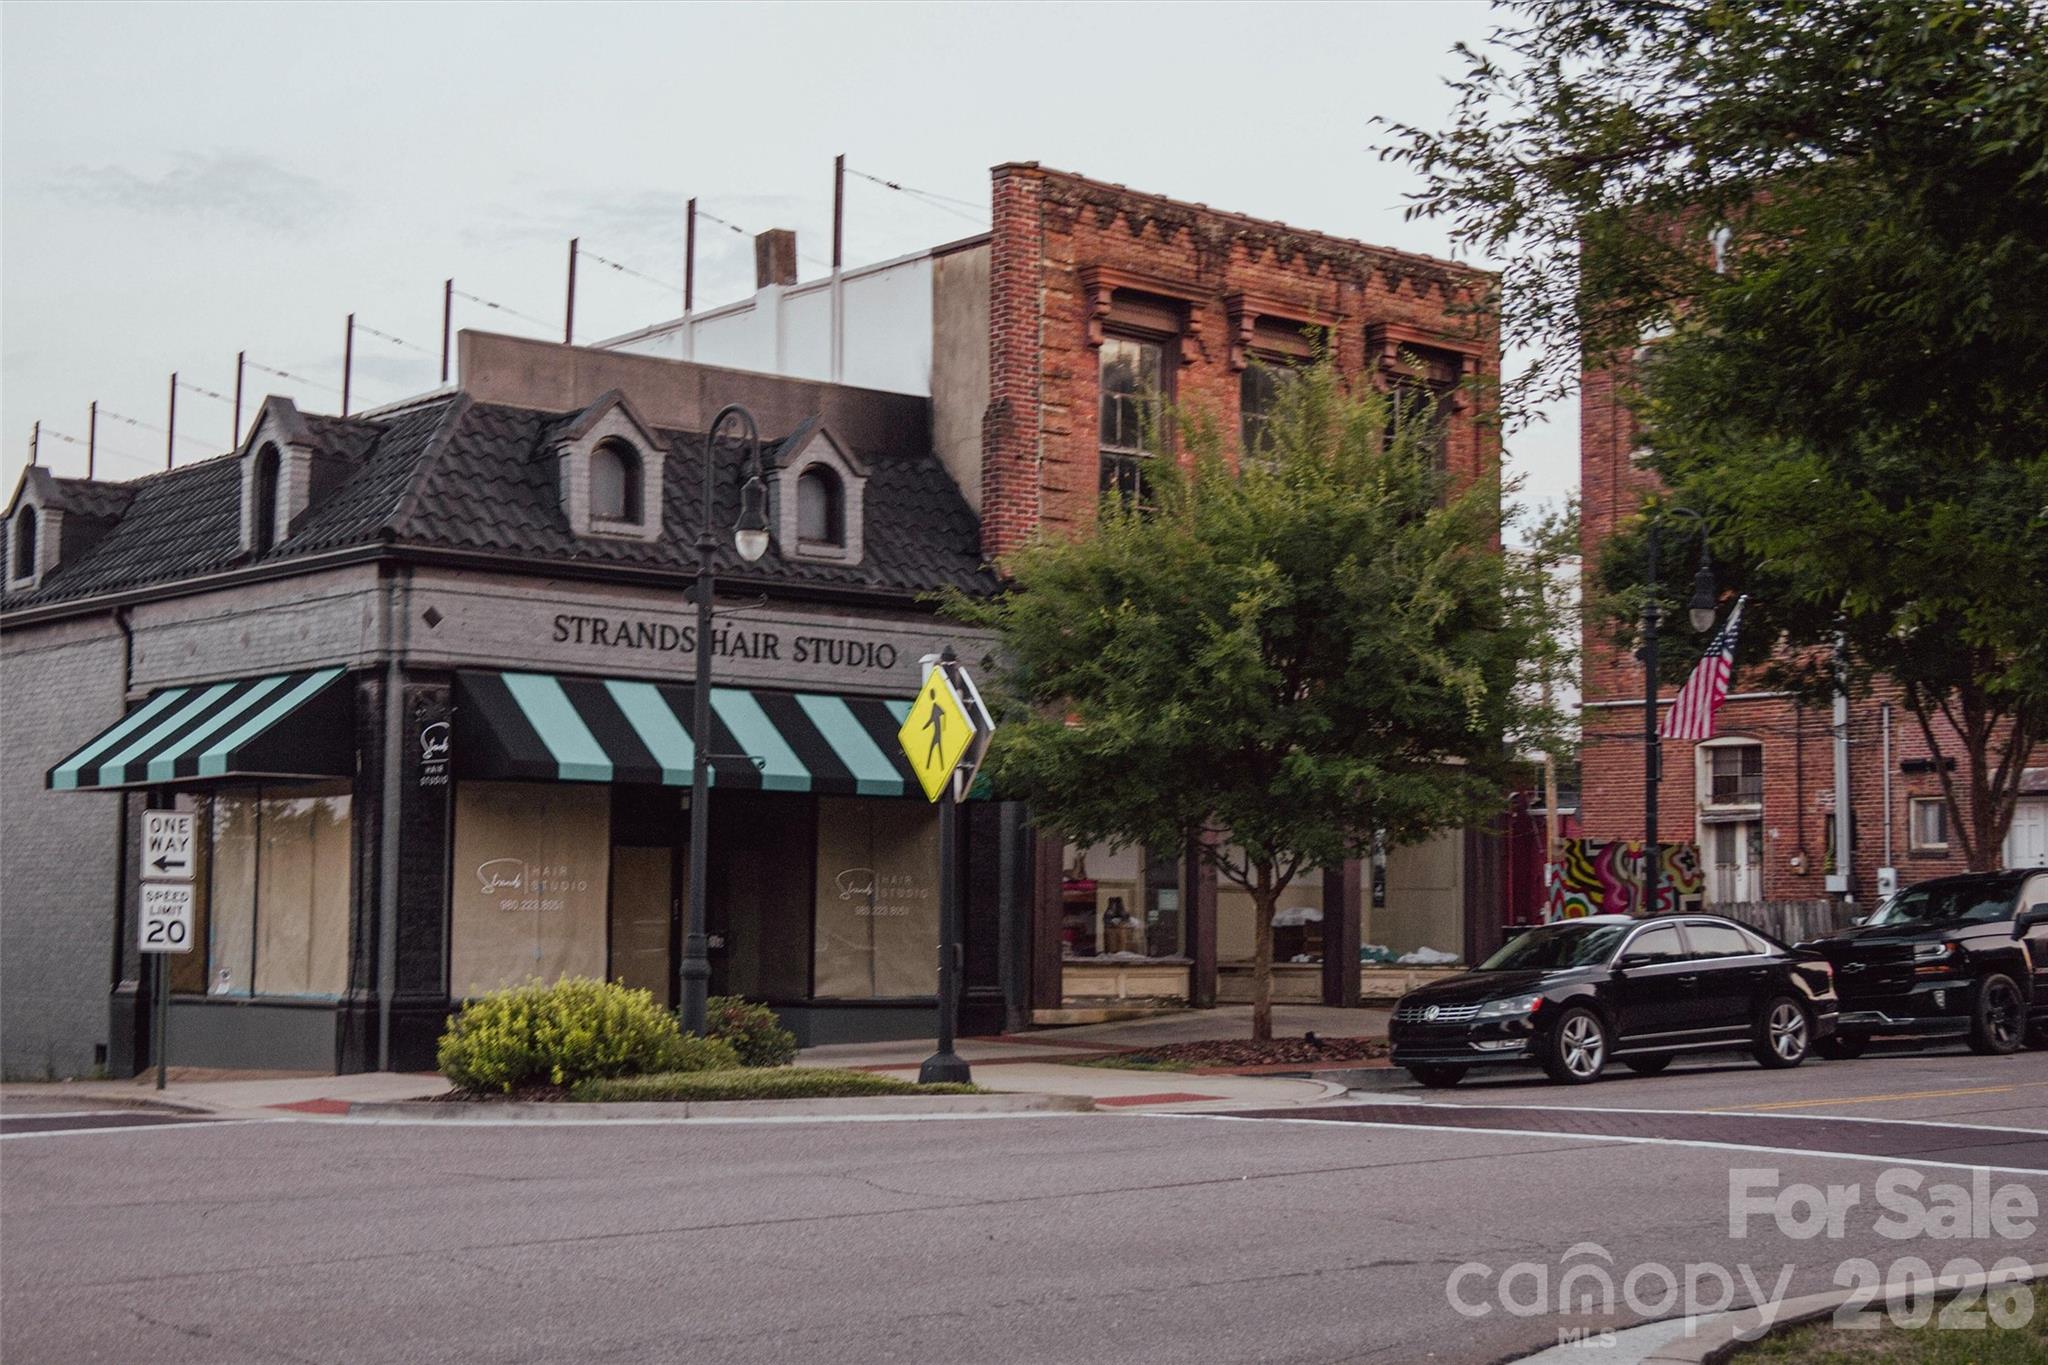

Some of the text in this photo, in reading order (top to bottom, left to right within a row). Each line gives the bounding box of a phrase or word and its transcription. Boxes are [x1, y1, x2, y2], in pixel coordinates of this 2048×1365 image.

[553, 614, 897, 669] STRANDS HAIR STUDIO
[150, 817, 189, 834] ONE
[149, 837, 189, 851] WAY
[530, 879, 588, 893] STUDIO
[145, 890, 189, 903] SPEED
[149, 904, 183, 916] LIMIT
[146, 920, 186, 943] 20
